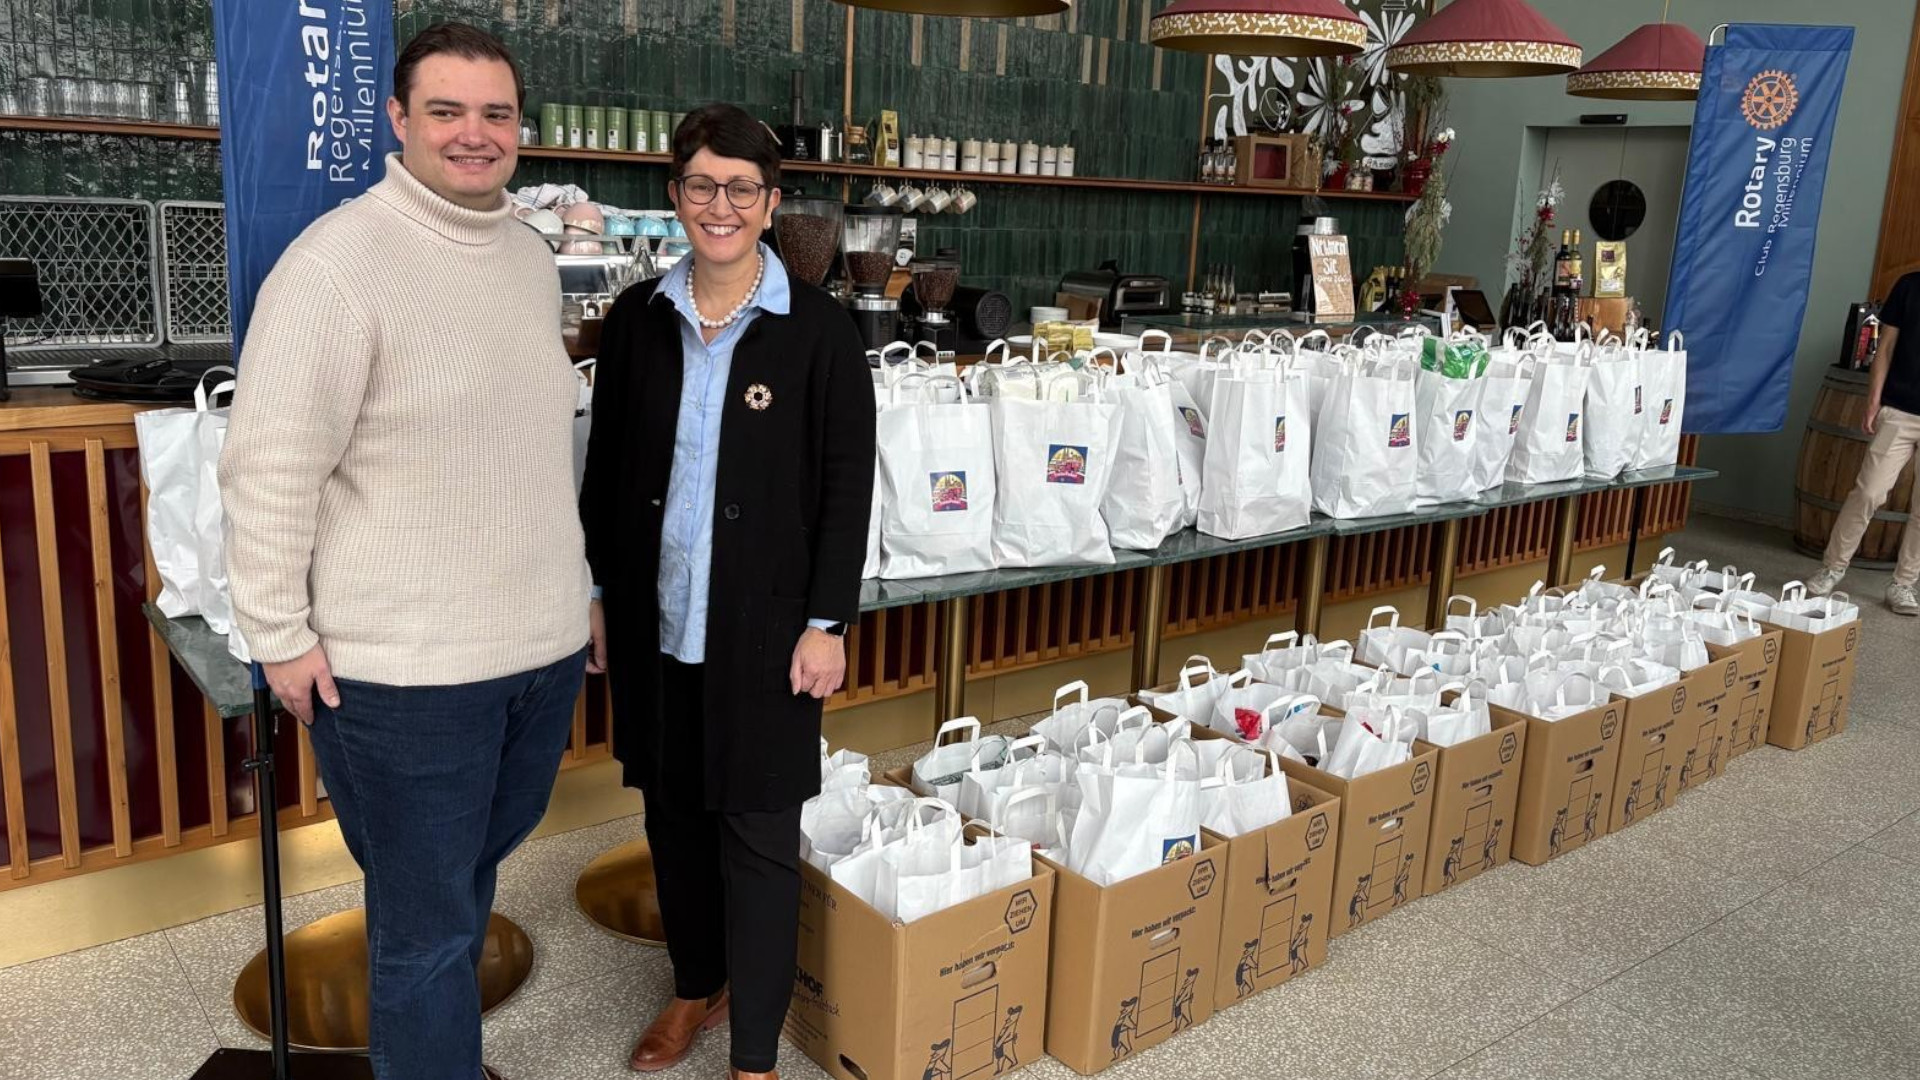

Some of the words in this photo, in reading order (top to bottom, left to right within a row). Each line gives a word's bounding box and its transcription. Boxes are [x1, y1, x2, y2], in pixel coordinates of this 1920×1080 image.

[299, 0, 330, 169] Rotar
[343, 0, 376, 170] Millenniu
[1735, 136, 1776, 228] Rotary
[1754, 239, 1772, 277] Club
[1767, 137, 1797, 234] Regensburg
[1777, 137, 1813, 228] Millennium
